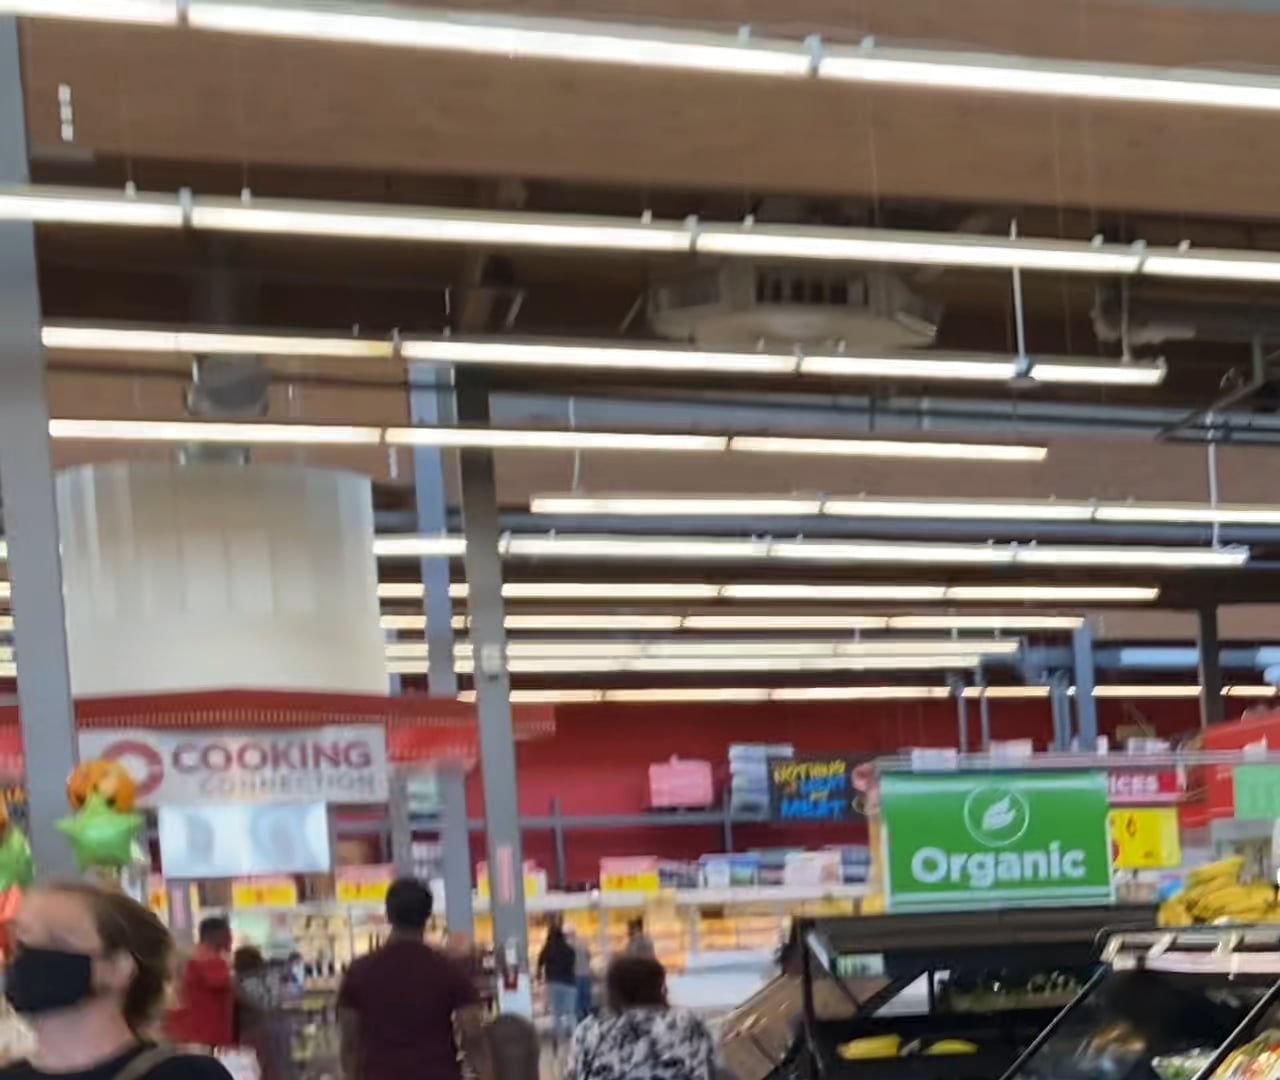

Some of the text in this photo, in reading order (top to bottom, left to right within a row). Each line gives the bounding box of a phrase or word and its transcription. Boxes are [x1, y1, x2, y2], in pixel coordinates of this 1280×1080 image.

[172, 741, 372, 773] COOKING
[1109, 774, 1158, 794] ICES
[911, 841, 1086, 888] Organic
